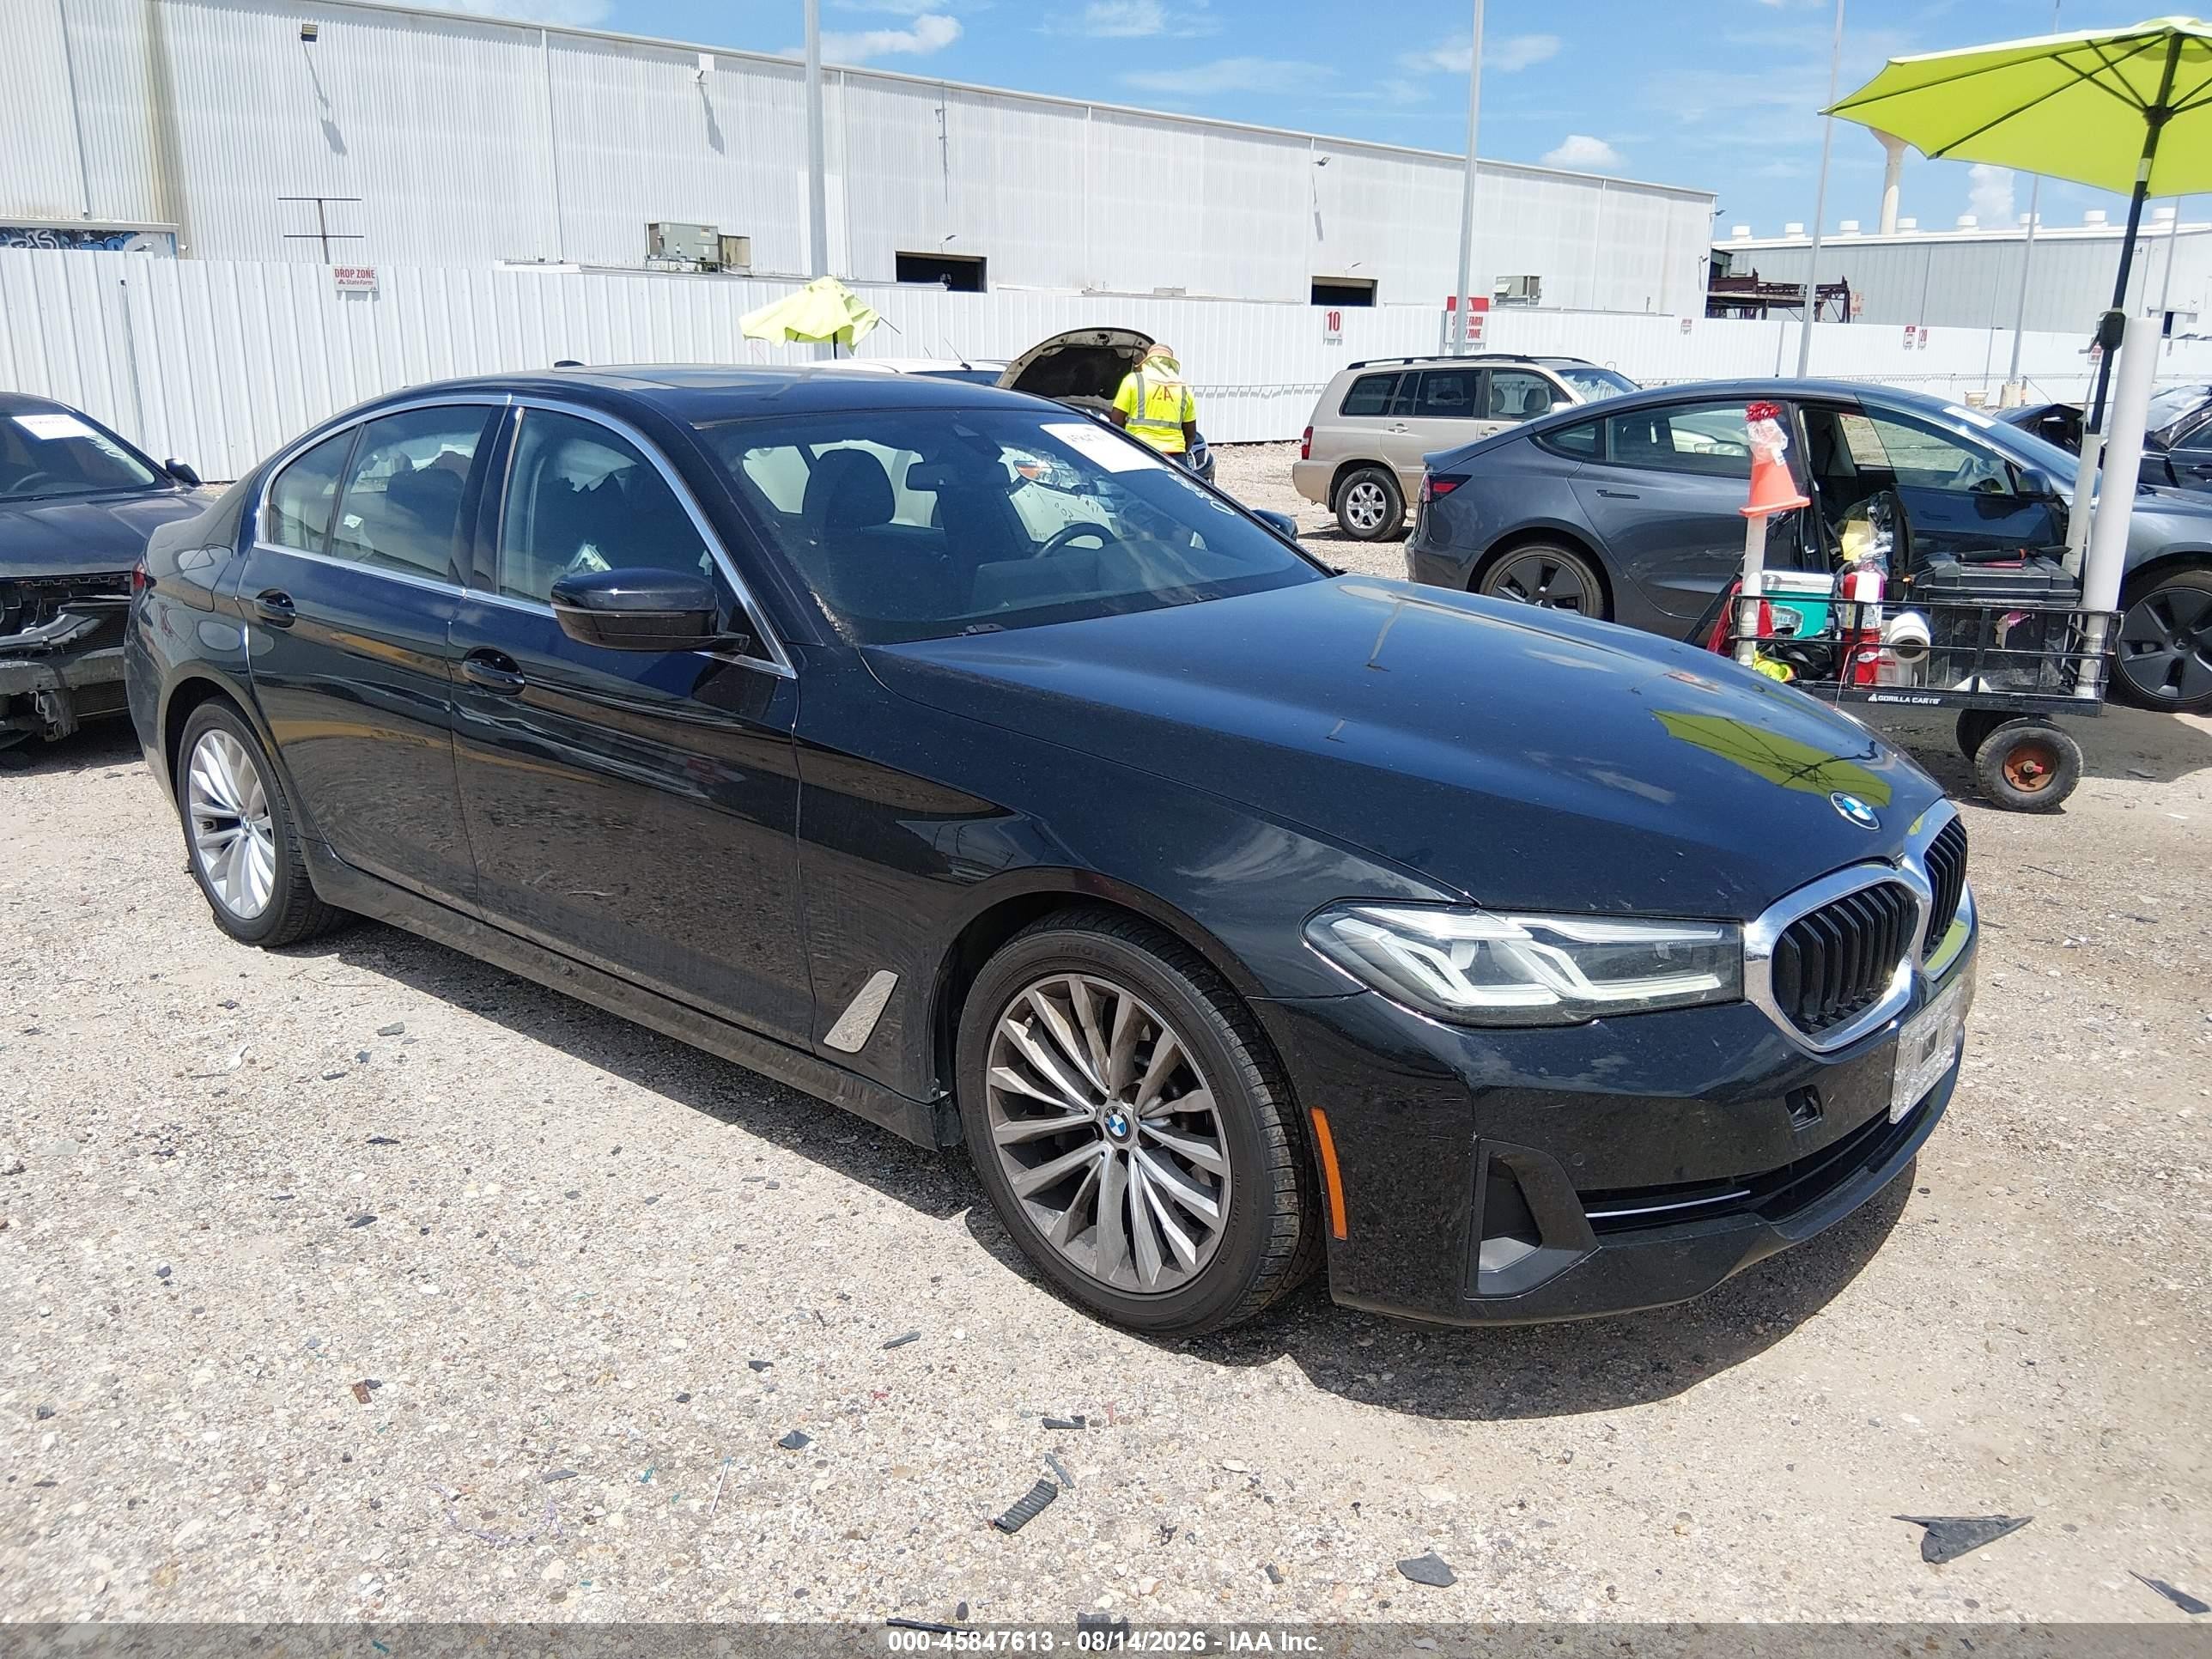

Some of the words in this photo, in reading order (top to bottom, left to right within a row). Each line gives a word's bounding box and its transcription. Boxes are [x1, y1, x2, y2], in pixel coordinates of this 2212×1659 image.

[334, 268, 355, 278] DROP
[356, 269, 375, 278] ZONE
[1327, 311, 1340, 331] 10
[1468, 328, 1482, 338] ZONE
[1878, 695, 1911, 703] GORILLA
